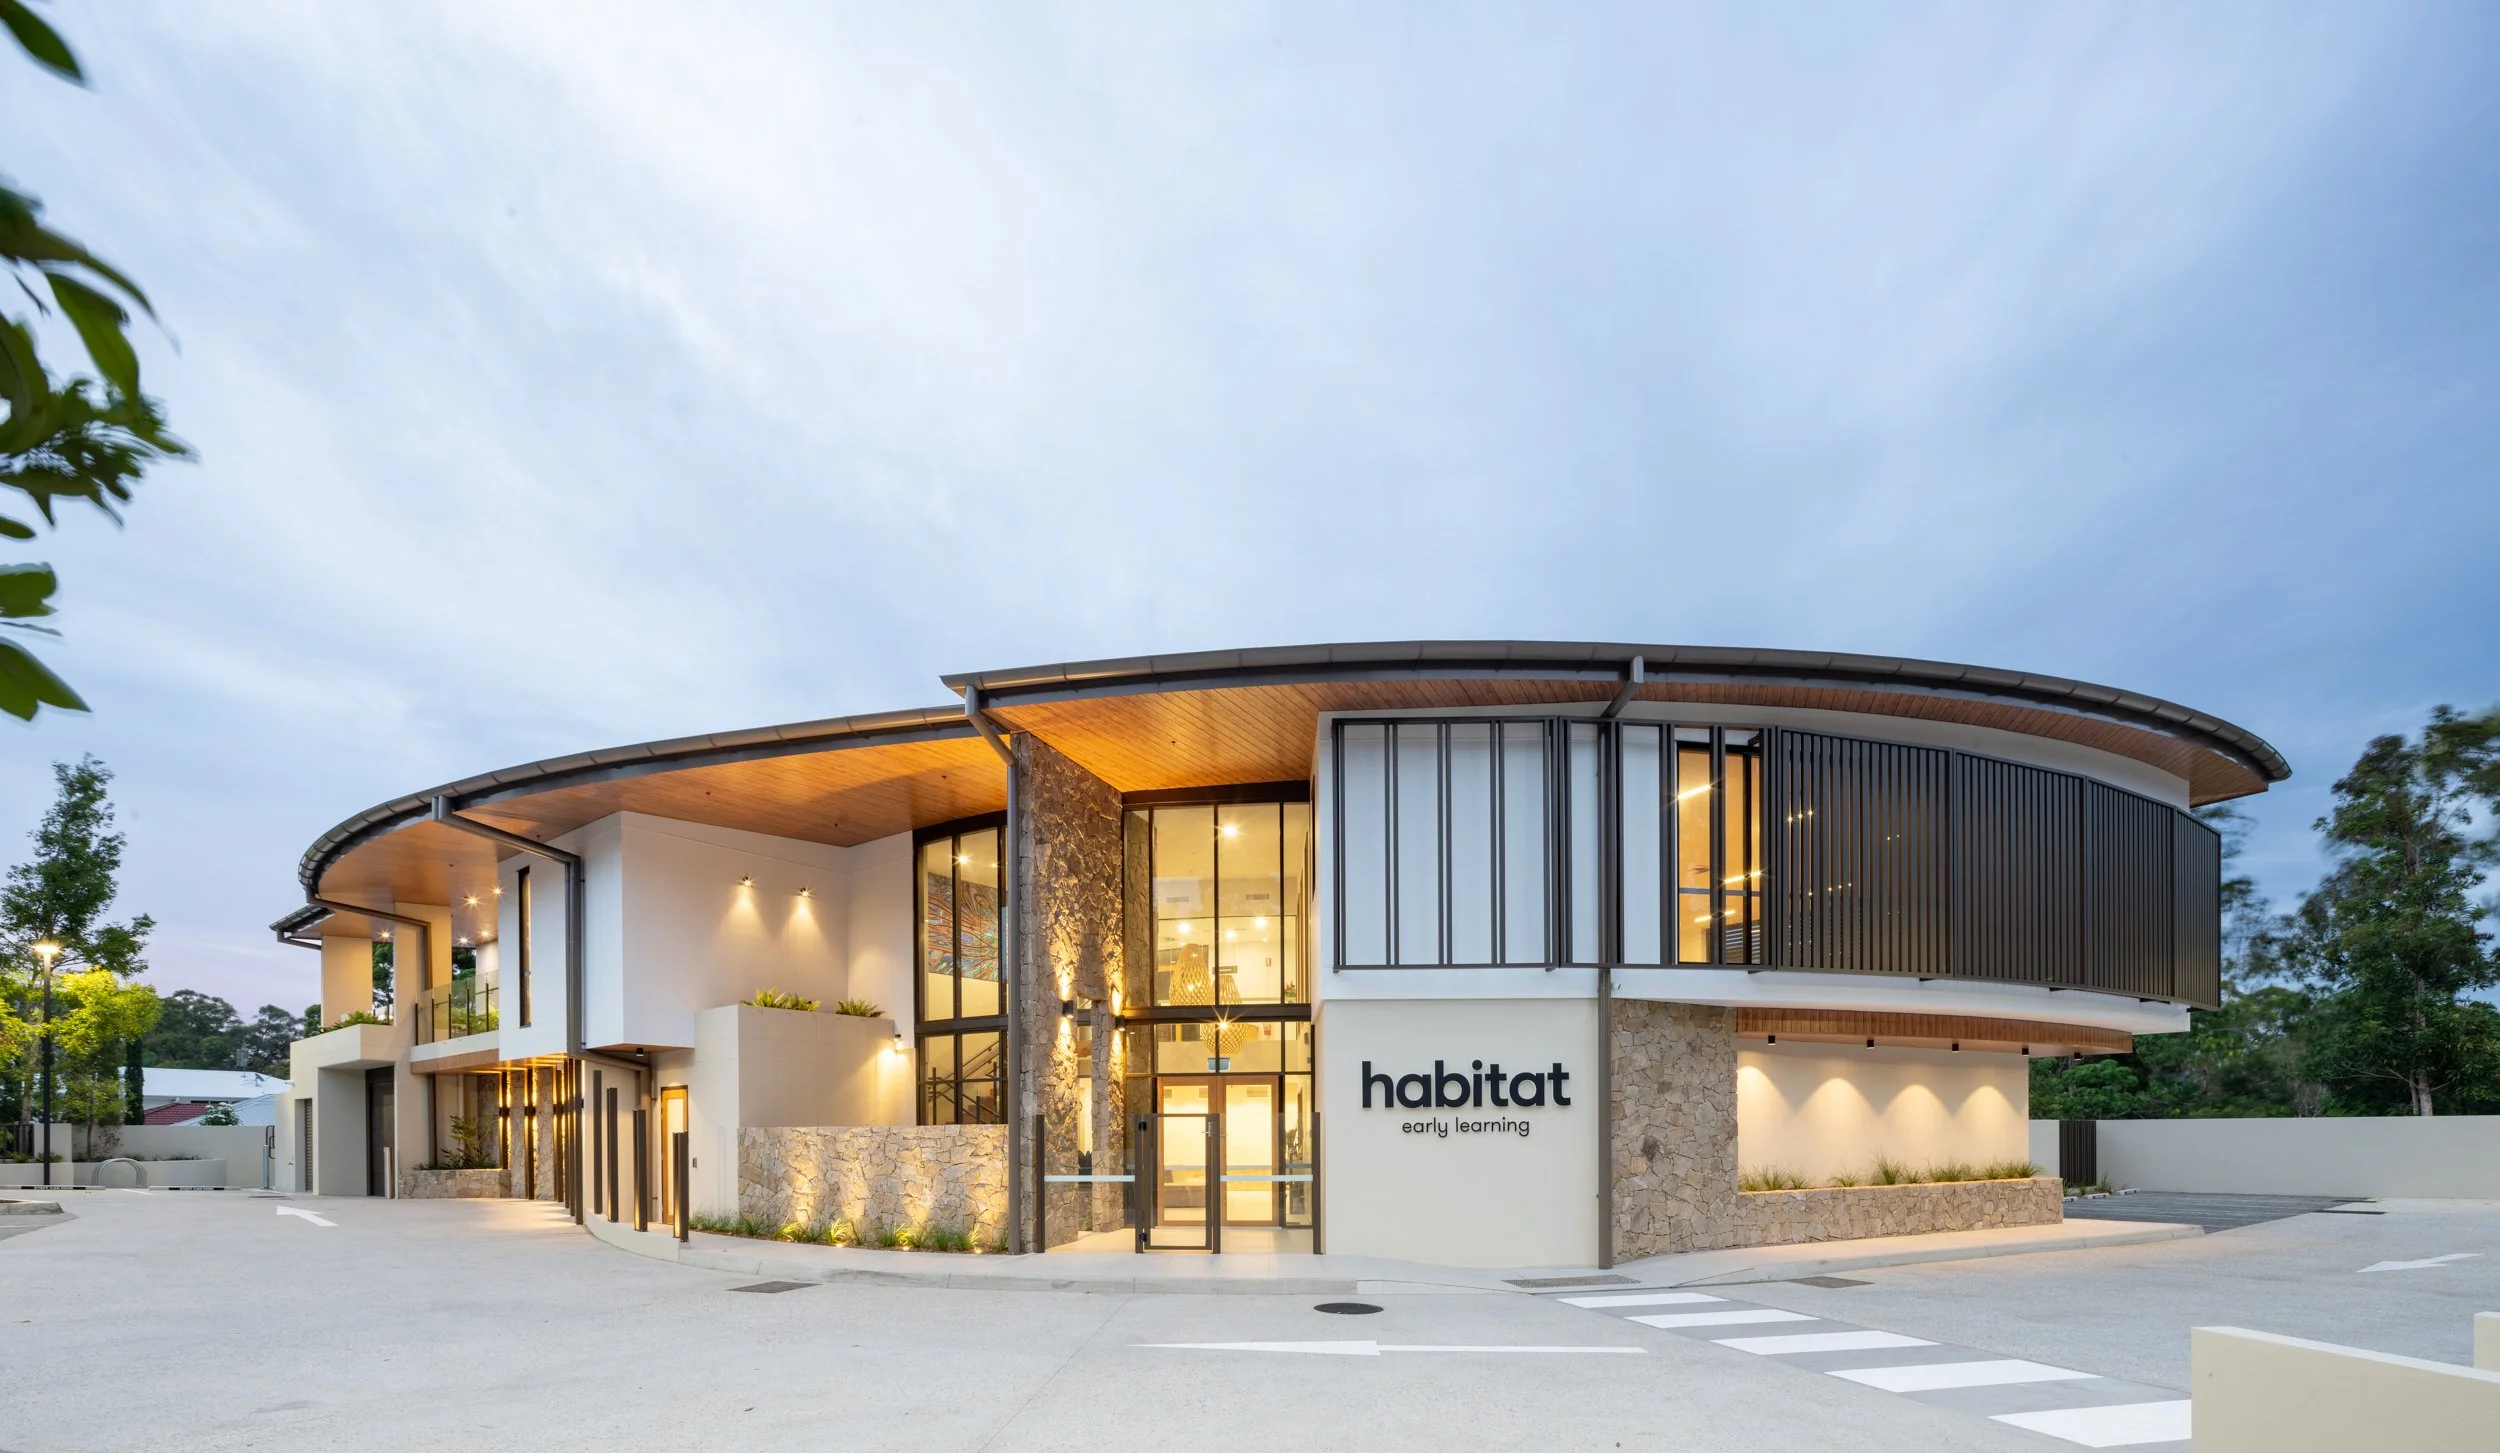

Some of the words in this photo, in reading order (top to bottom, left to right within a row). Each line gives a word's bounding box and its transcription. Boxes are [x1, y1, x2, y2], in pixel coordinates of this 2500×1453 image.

[1361, 1060, 1571, 1109] habitat
[1402, 1117, 1448, 1139] early
[1455, 1117, 1530, 1137] learning
